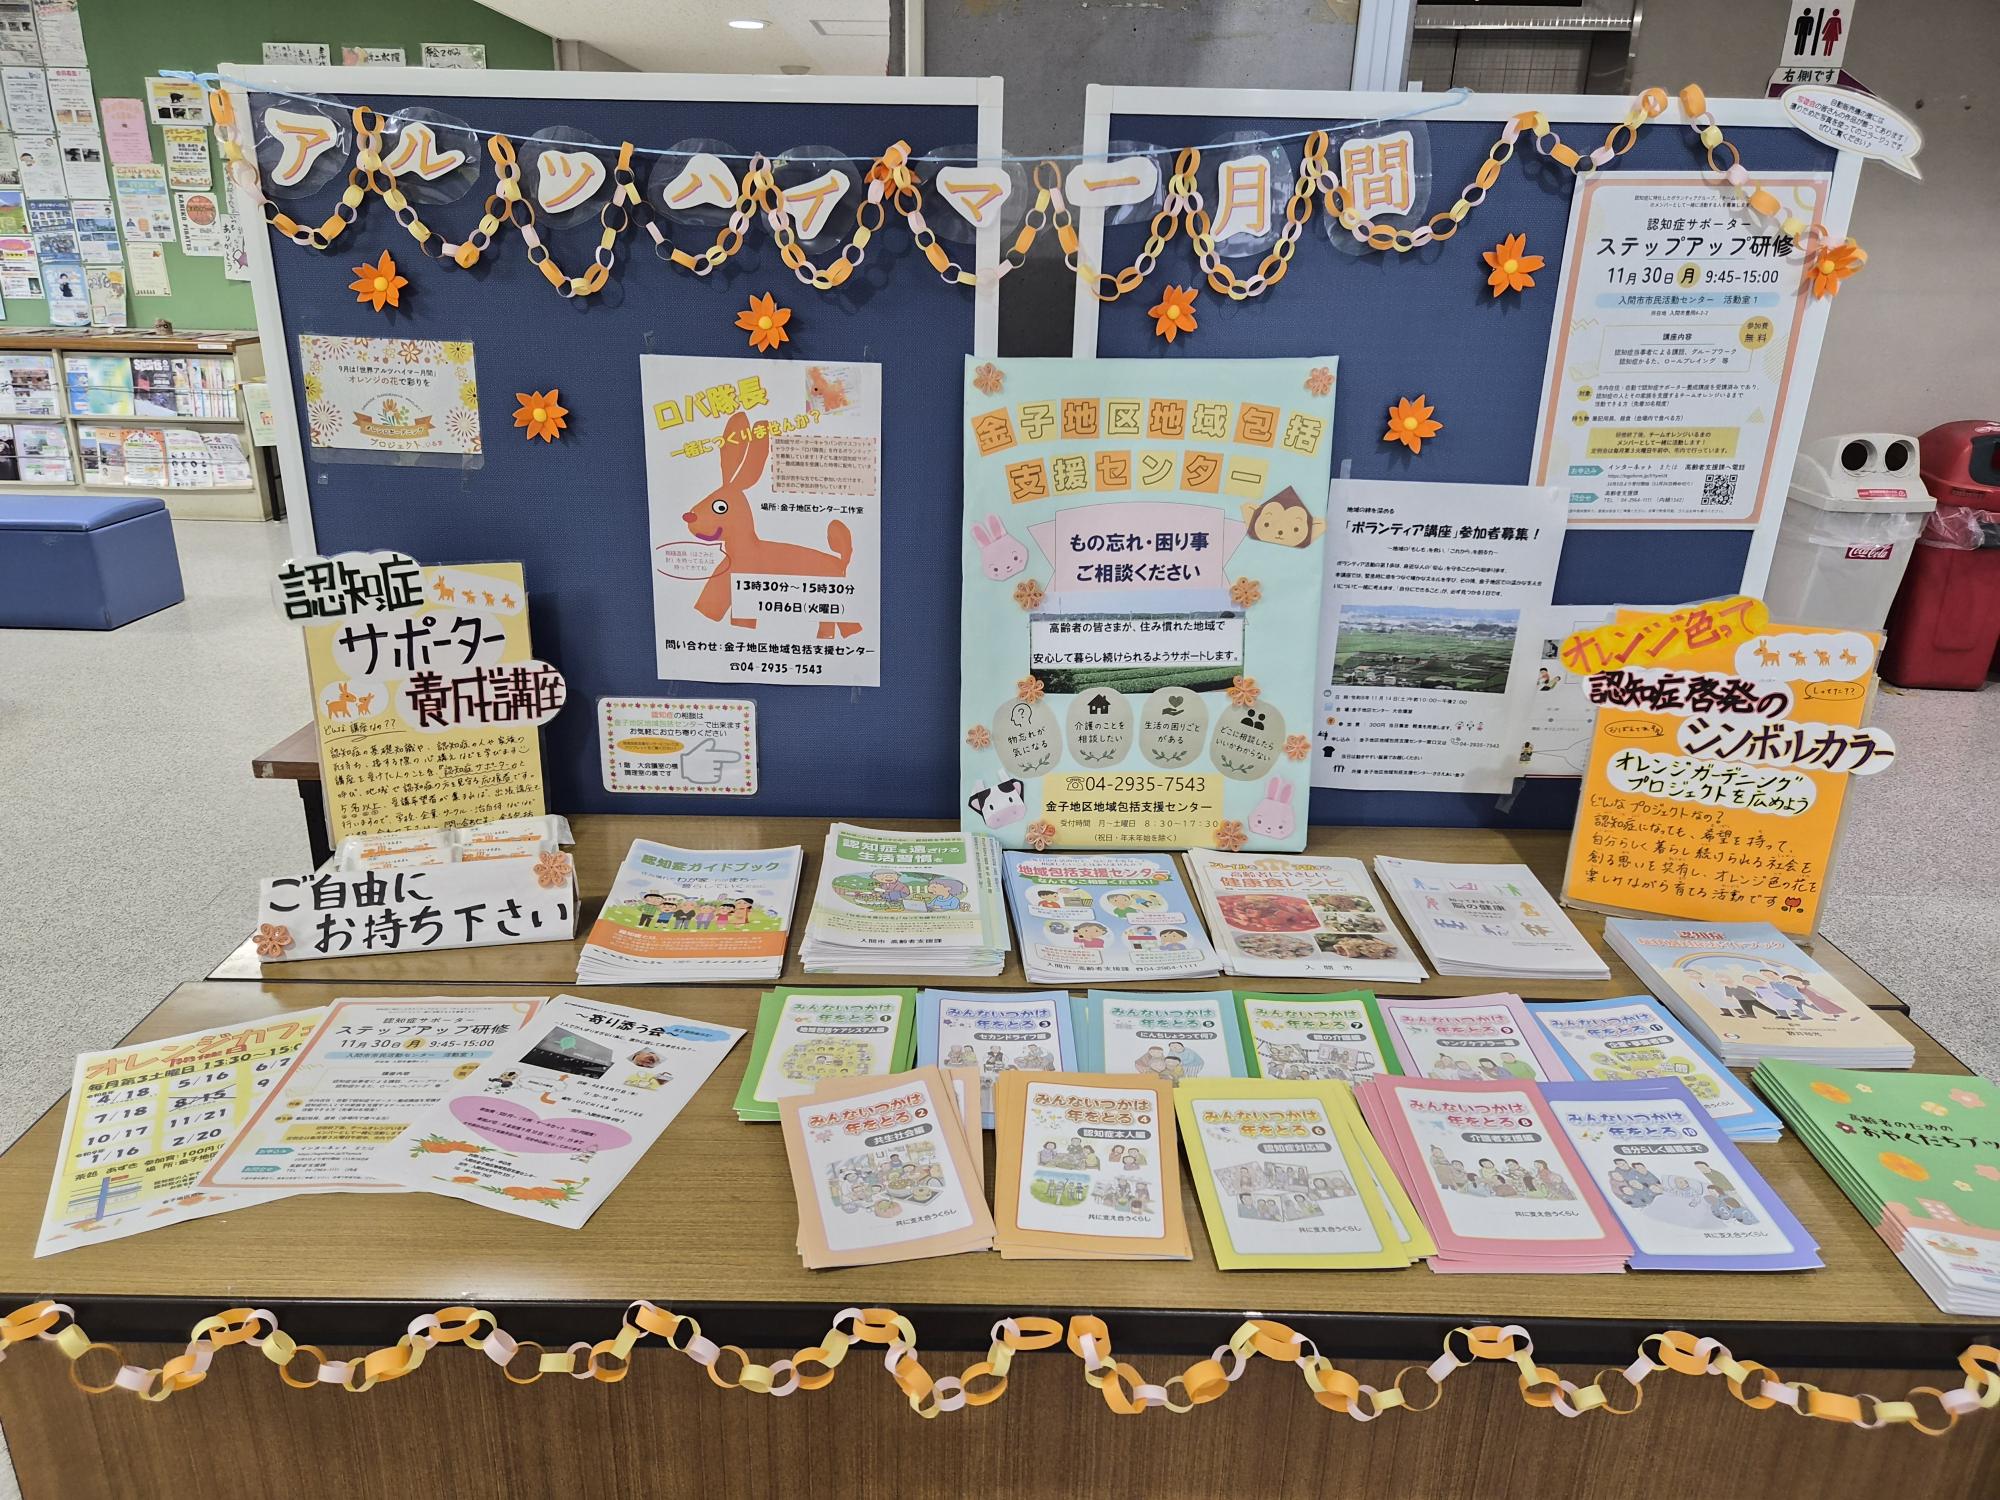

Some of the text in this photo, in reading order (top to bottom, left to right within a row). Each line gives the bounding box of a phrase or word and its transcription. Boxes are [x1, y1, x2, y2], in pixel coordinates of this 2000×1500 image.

[1783, 69, 1834, 82] 右側です
[1647, 218, 1751, 231] 認知症サポーター
[1597, 236, 1794, 258] ステップアップ研修
[1681, 269, 1695, 284] 月
[1705, 270, 1779, 285] 9:45-15:00
[1619, 295, 1715, 306] 入間市市民活動センター
[1662, 333, 1692, 342] 講座内容
[348, 376, 431, 387] オレンジの花で彩りを
[653, 375, 769, 431] ロバ隊長
[670, 410, 821, 460] 一緒につくりませんか？
[976, 401, 1322, 453] 金子地区地域包括
[370, 438, 420, 450] プロジェクト
[1008, 455, 1261, 499] 支援センター
[1344, 521, 1540, 541] 「ボランティア講座」参加者募集！
[1070, 532, 1210, 552] もの忘れ・困り事
[1076, 564, 1200, 583] ご相談ください
[278, 554, 424, 619] 認知症
[1049, 620, 1226, 634] 高齢者の皆さまが、住み慣れた地域で
[1563, 600, 1755, 673] オレンジ色って
[339, 616, 505, 674] サポーター
[1033, 651, 1238, 664] 安心して暮らし続けられるようサポートします。
[405, 665, 565, 727] 養成講座
[1588, 670, 1788, 719] 認知症啓発の
[630, 728, 727, 737] お気軽にお立ち寄りください
[1074, 721, 1125, 731] 介護のことを
[1144, 721, 1200, 733] 生活の困りごと
[1008, 727, 1046, 745] 物忘れが
[1078, 734, 1123, 744] 相談したい
[1158, 735, 1184, 745] がある
[1219, 725, 1274, 751] どこに相談したら
[1684, 718, 1895, 769] シンボルカラー
[1012, 739, 1048, 758] 気になる
[1216, 739, 1271, 762] いいかわからない
[1615, 755, 1804, 791] オレンジガーデニング
[1086, 776, 1206, 792] 04-2935-7543
[1628, 777, 1809, 813] プロジェクトを広めよう
[1046, 801, 1212, 813] 金子地区地域包括支援センター
[1060, 819, 1091, 828] 受付時間
[640, 854, 781, 873] 認知症ガイドブック
[1018, 864, 1168, 878] 地域包括支援センター
[269, 871, 434, 912] ご自由に
[1220, 877, 1345, 887] 健康食レシピ
[314, 898, 568, 953] お持ち下さい
[335, 1023, 510, 1036] ステップアップ研修
[407, 1039, 420, 1048] 月
[429, 1039, 495, 1048] 9:45-15:00
[88, 1065, 195, 1092] 毎月第3土曜日
[178, 1072, 229, 1088] 5/16
[97, 1088, 150, 1104] 4/18
[95, 1106, 148, 1124] 7/18
[170, 1108, 226, 1128] 11/21
[1849, 1113, 1953, 1132] 高齢者のための
[88, 1126, 148, 1146] 10/17
[173, 1128, 222, 1147] 2/20
[91, 1146, 139, 1163] 1/16
